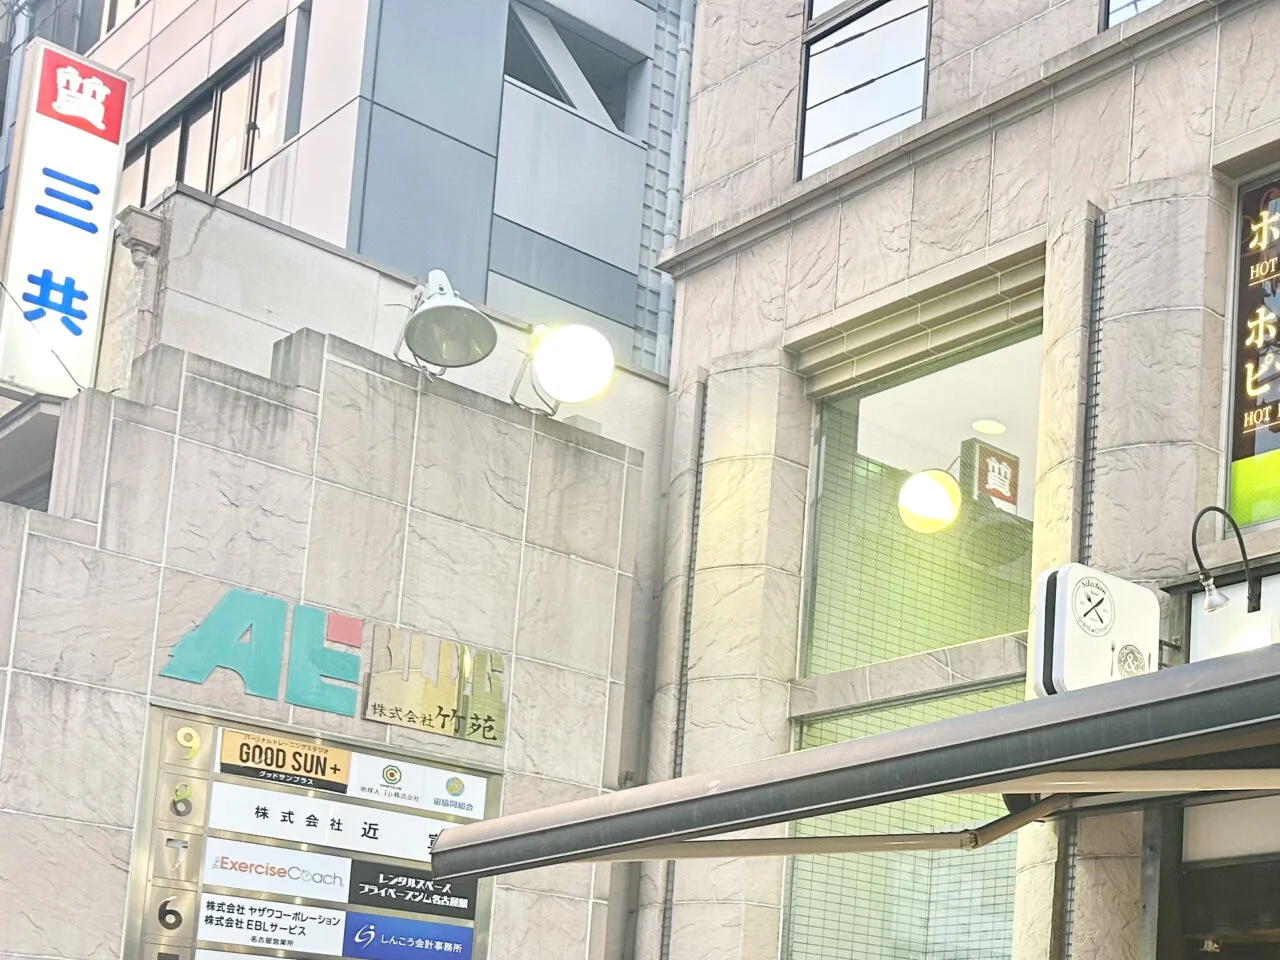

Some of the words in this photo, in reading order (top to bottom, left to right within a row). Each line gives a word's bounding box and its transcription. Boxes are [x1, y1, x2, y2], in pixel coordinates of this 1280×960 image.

[52, 65, 112, 131] 質
[22, 167, 100, 336] 三共
[1249, 257, 1278, 282] HOT
[1243, 404, 1272, 429] HOT
[370, 702, 498, 741] 株式会社竹苑
[176, 726, 201, 761] 9
[238, 741, 288, 770] GOOD
[291, 750, 328, 777] SUN
[169, 782, 193, 817] 8
[165, 837, 190, 873] 7
[378, 873, 452, 894] レンタルスペース
[157, 895, 183, 931] 6
[204, 914, 245, 930] 株式会社
[246, 919, 307, 937] EBLサービス
[206, 900, 246, 916] 株式会社
[248, 906, 341, 926] ヤザワコーポレーション
[250, 935, 295, 947] 名古屋営業所
[381, 934, 463, 954] しんこう会計事務所
